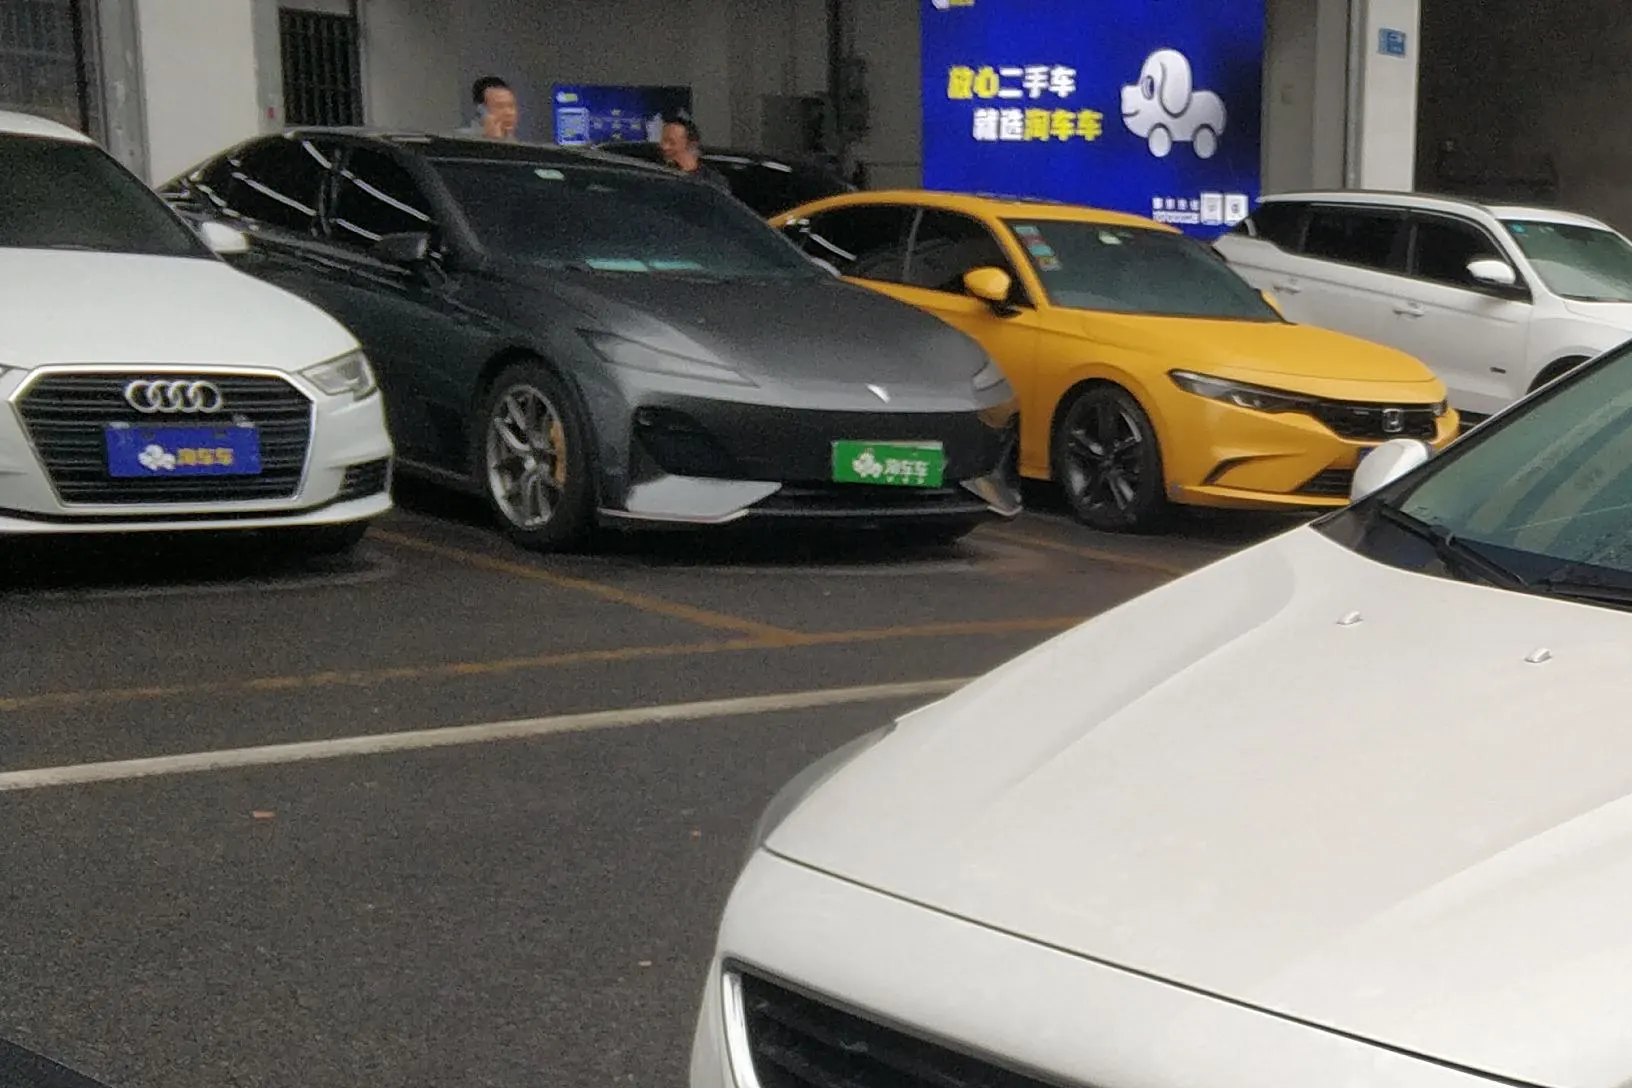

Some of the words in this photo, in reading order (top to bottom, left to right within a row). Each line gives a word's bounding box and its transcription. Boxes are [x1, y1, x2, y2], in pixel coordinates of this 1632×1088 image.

[947, 65, 1076, 99] 放心二手车
